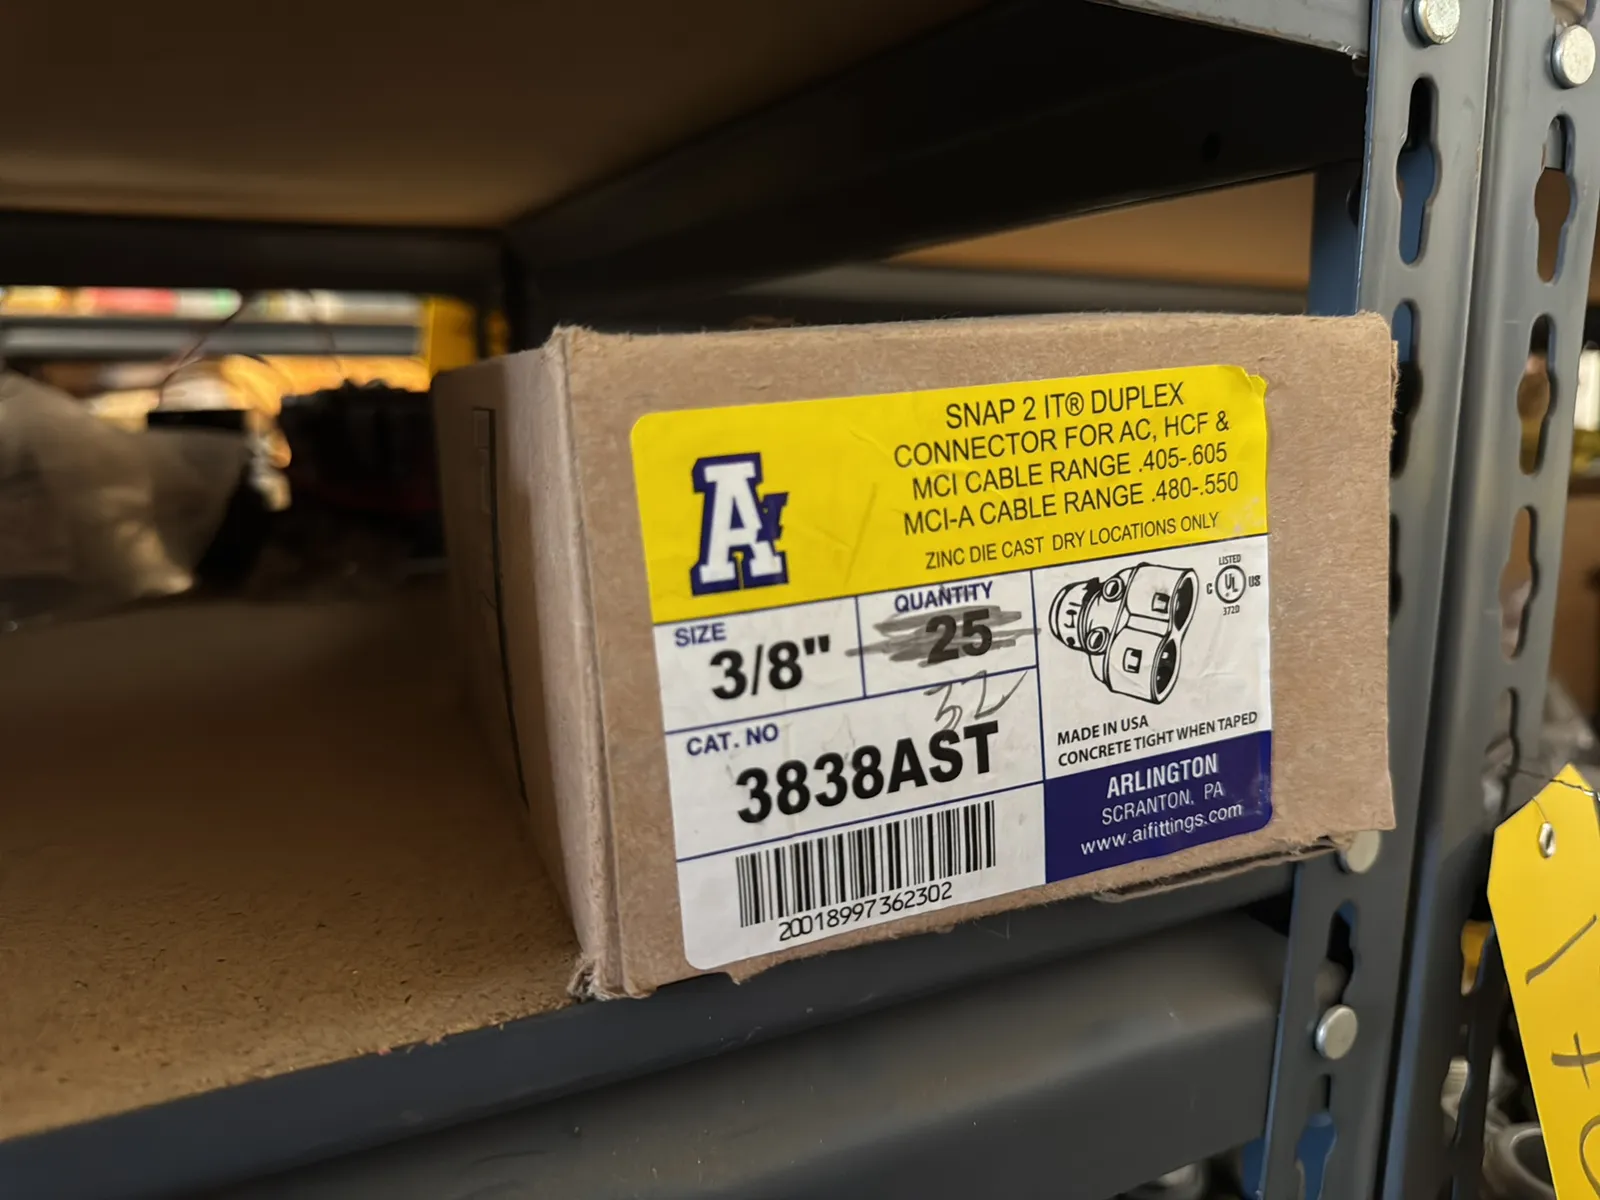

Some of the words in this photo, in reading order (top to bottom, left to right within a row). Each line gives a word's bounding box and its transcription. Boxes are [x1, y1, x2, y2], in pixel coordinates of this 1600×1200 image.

[945, 399, 1016, 429] SNAP
[1022, 396, 1036, 422] 2
[1044, 391, 1085, 419] IT®
[1091, 382, 1184, 414] DUPLEX
[894, 428, 1057, 468] CONNECTOR
[1065, 422, 1114, 450] FOR
[1119, 418, 1157, 443] AC,
[1165, 411, 1208, 437] HCF
[1215, 410, 1230, 432] &
[912, 473, 957, 500] MCI
[965, 461, 1043, 493] CABLE
[1050, 452, 1131, 482] RANGE
[1138, 441, 1228, 473] .405-.605
[903, 506, 975, 536] MCI-A
[979, 494, 1058, 525] CABLE
[1064, 483, 1144, 514] RANGE
[1150, 470, 1239, 503] .480-.550
[925, 547, 966, 570] ZINC
[969, 543, 997, 563] DIE
[1001, 536, 1044, 558] CAST
[1051, 530, 1086, 552] DRY
[1089, 518, 1177, 546] LOCATIONS
[1180, 511, 1221, 533] ONLY
[1218, 554, 1242, 566] LISTED
[894, 581, 993, 613] QUANTITY
[1248, 575, 1261, 588] US
[674, 622, 727, 648] SIZE
[925, 608, 993, 666] 25
[709, 634, 831, 701] 3/8"
[686, 732, 740, 757] CAT.
[746, 722, 780, 745] NO
[1057, 721, 1101, 745] MADE
[1103, 718, 1117, 735] IN
[1121, 715, 1149, 732] USA
[1057, 739, 1132, 767] CONCRETE
[1134, 730, 1175, 749] TIGHT
[1177, 721, 1215, 741] WHEN
[1216, 711, 1258, 732] TAPED
[735, 720, 999, 824] 3838AST
[1106, 753, 1218, 799] ARLINGTON
[1204, 781, 1225, 800] PA
[1080, 804, 1243, 855] www.aifittings.com
[779, 881, 953, 942] 20018997362302
